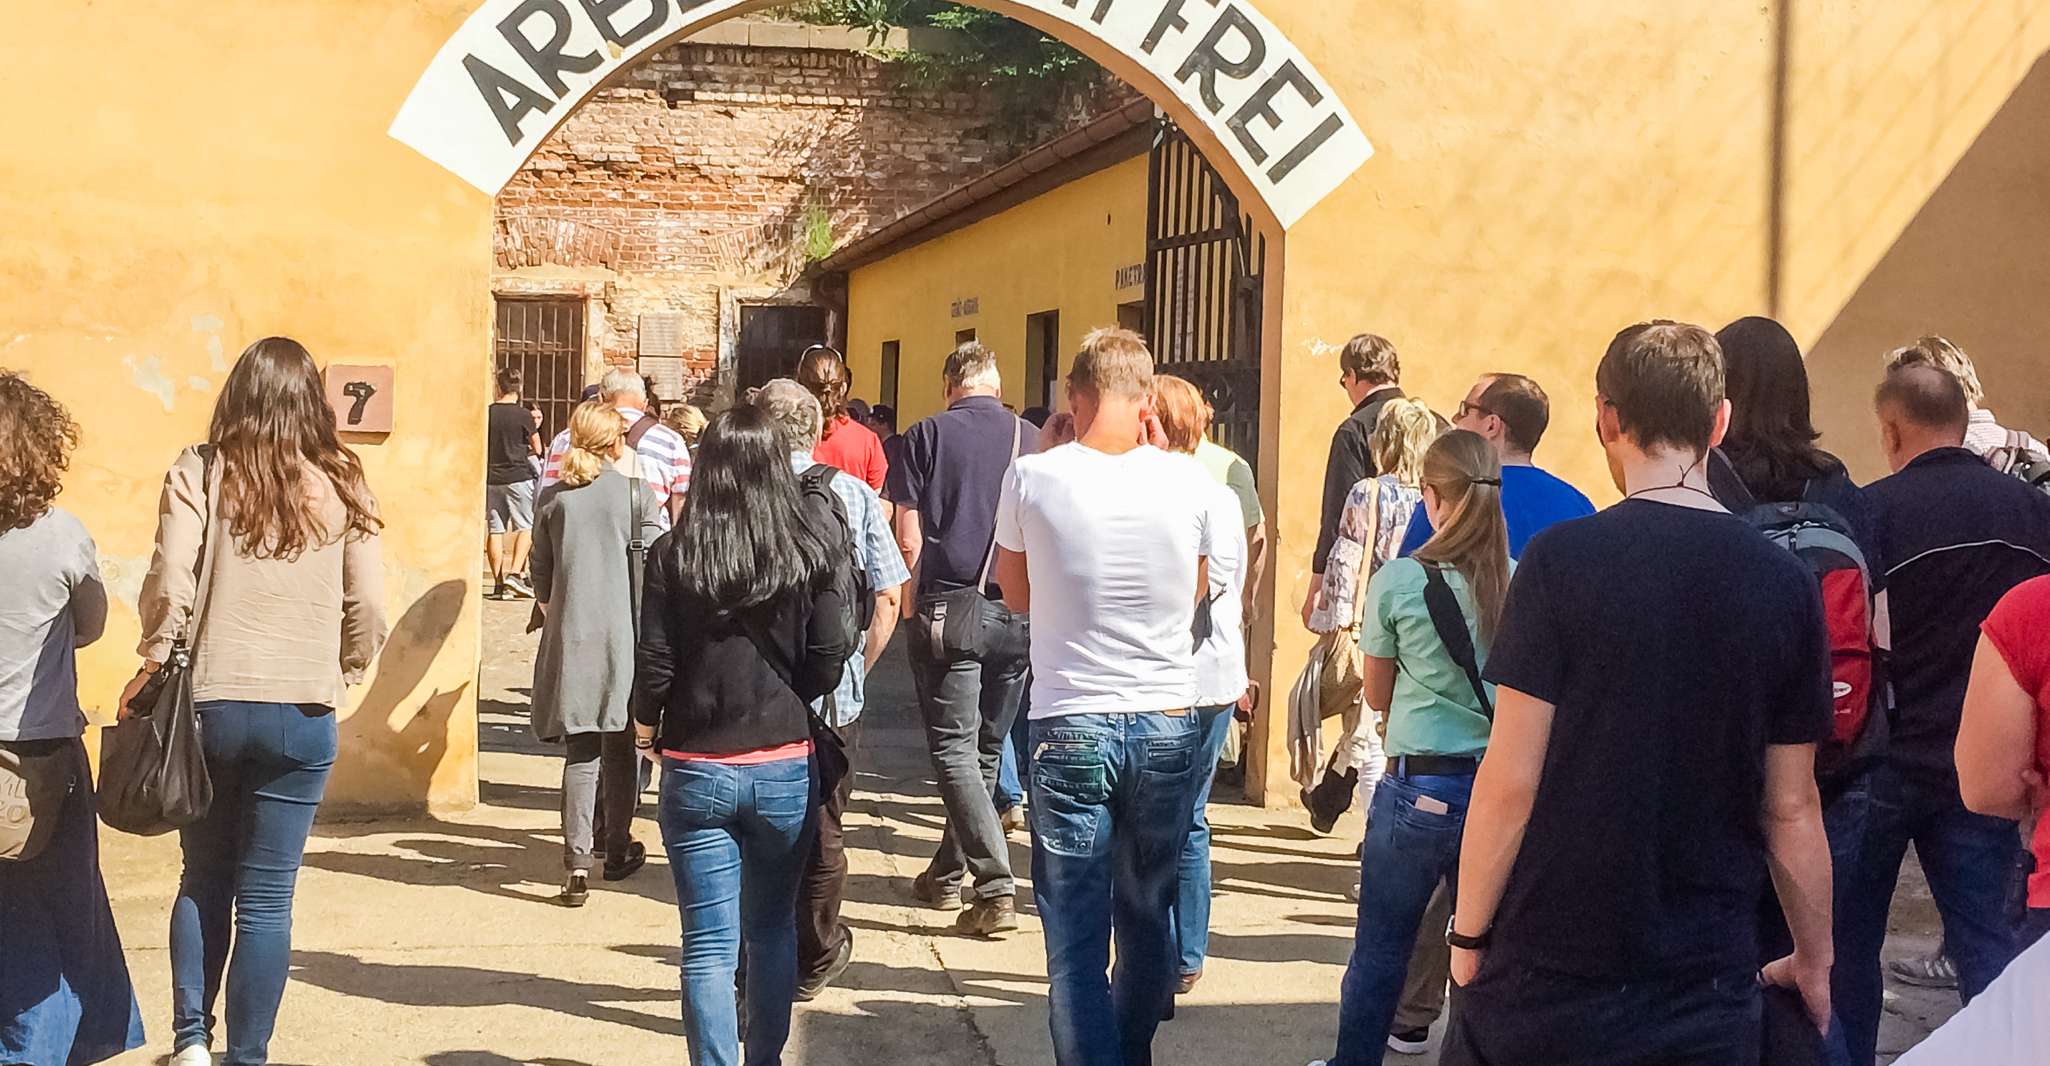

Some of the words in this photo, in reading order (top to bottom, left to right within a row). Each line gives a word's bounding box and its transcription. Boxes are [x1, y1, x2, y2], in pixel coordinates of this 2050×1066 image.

[462, 0, 713, 147] ARB
[1140, 0, 1344, 185] FREI
[1115, 263, 1145, 291] PAKETR
[343, 382, 377, 425] 7
